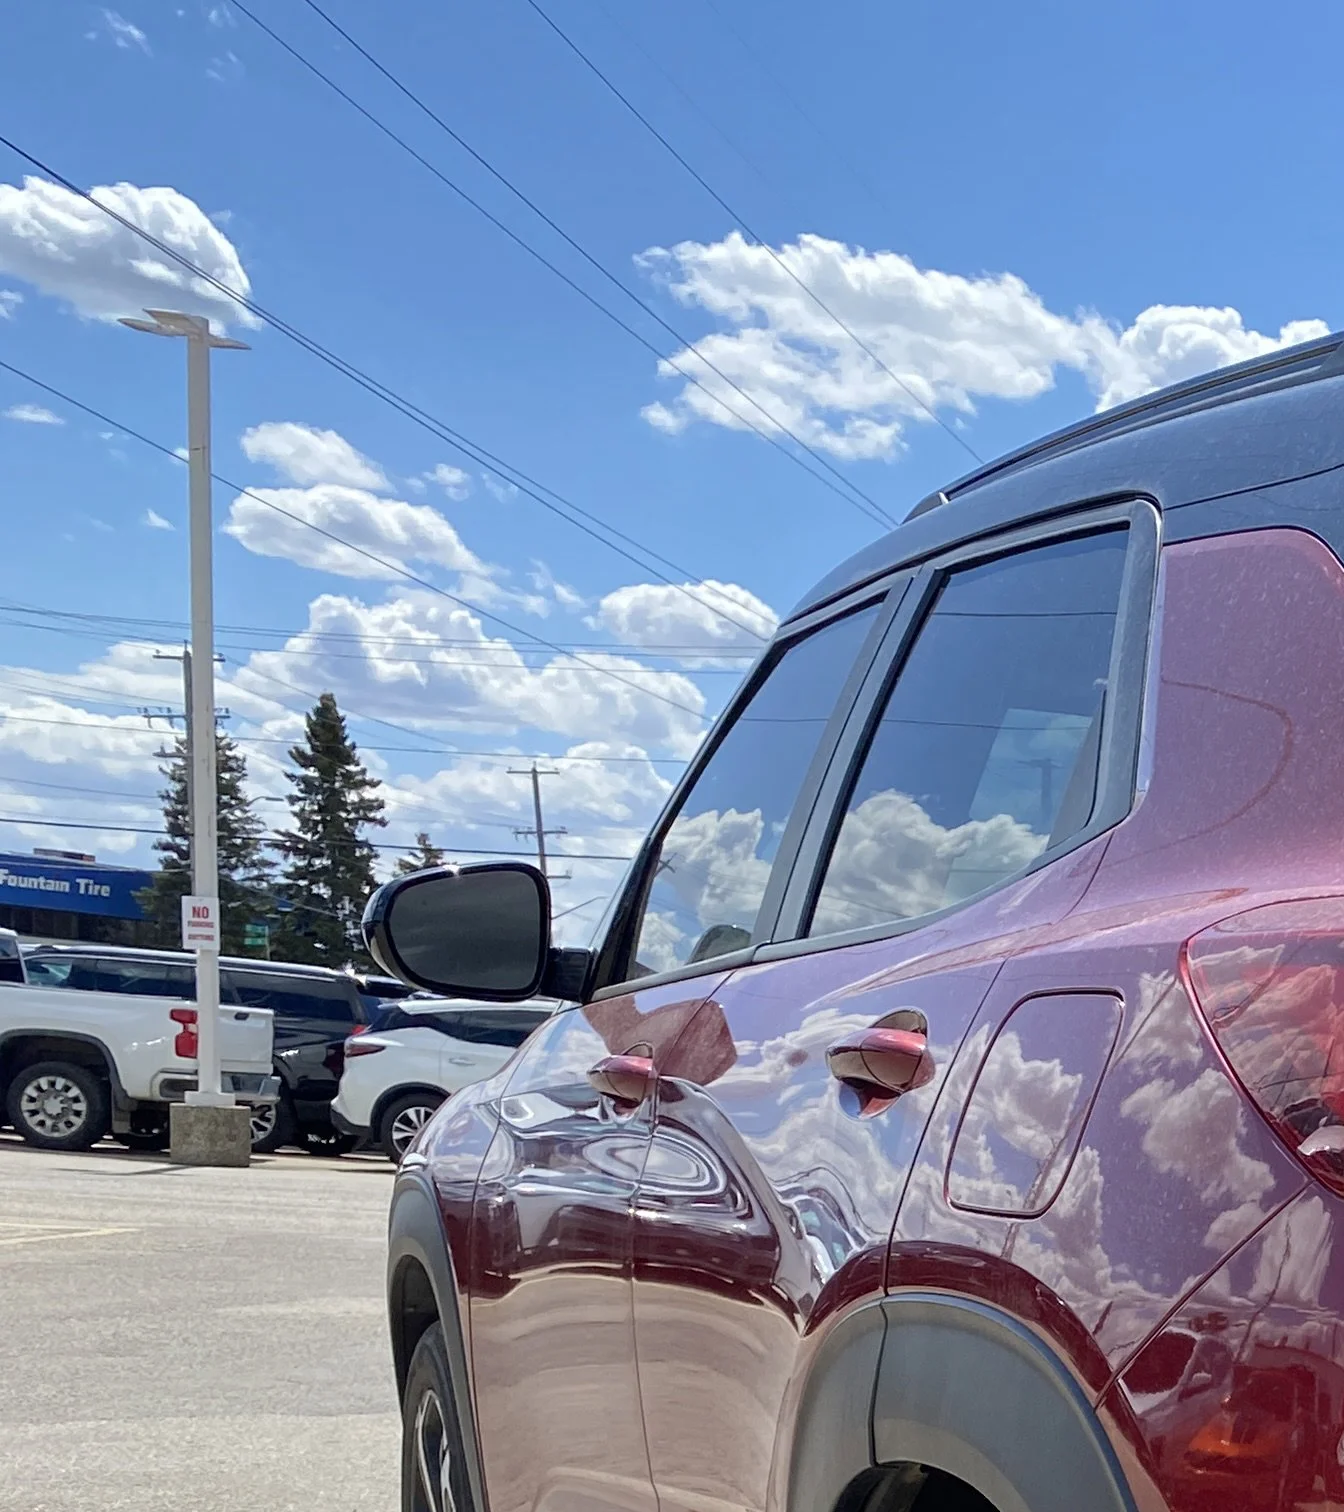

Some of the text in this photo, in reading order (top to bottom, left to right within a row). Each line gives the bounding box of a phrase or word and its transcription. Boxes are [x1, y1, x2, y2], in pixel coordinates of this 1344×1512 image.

[0, 869, 111, 897] Fountain Tire
[192, 906, 209, 919] NO
